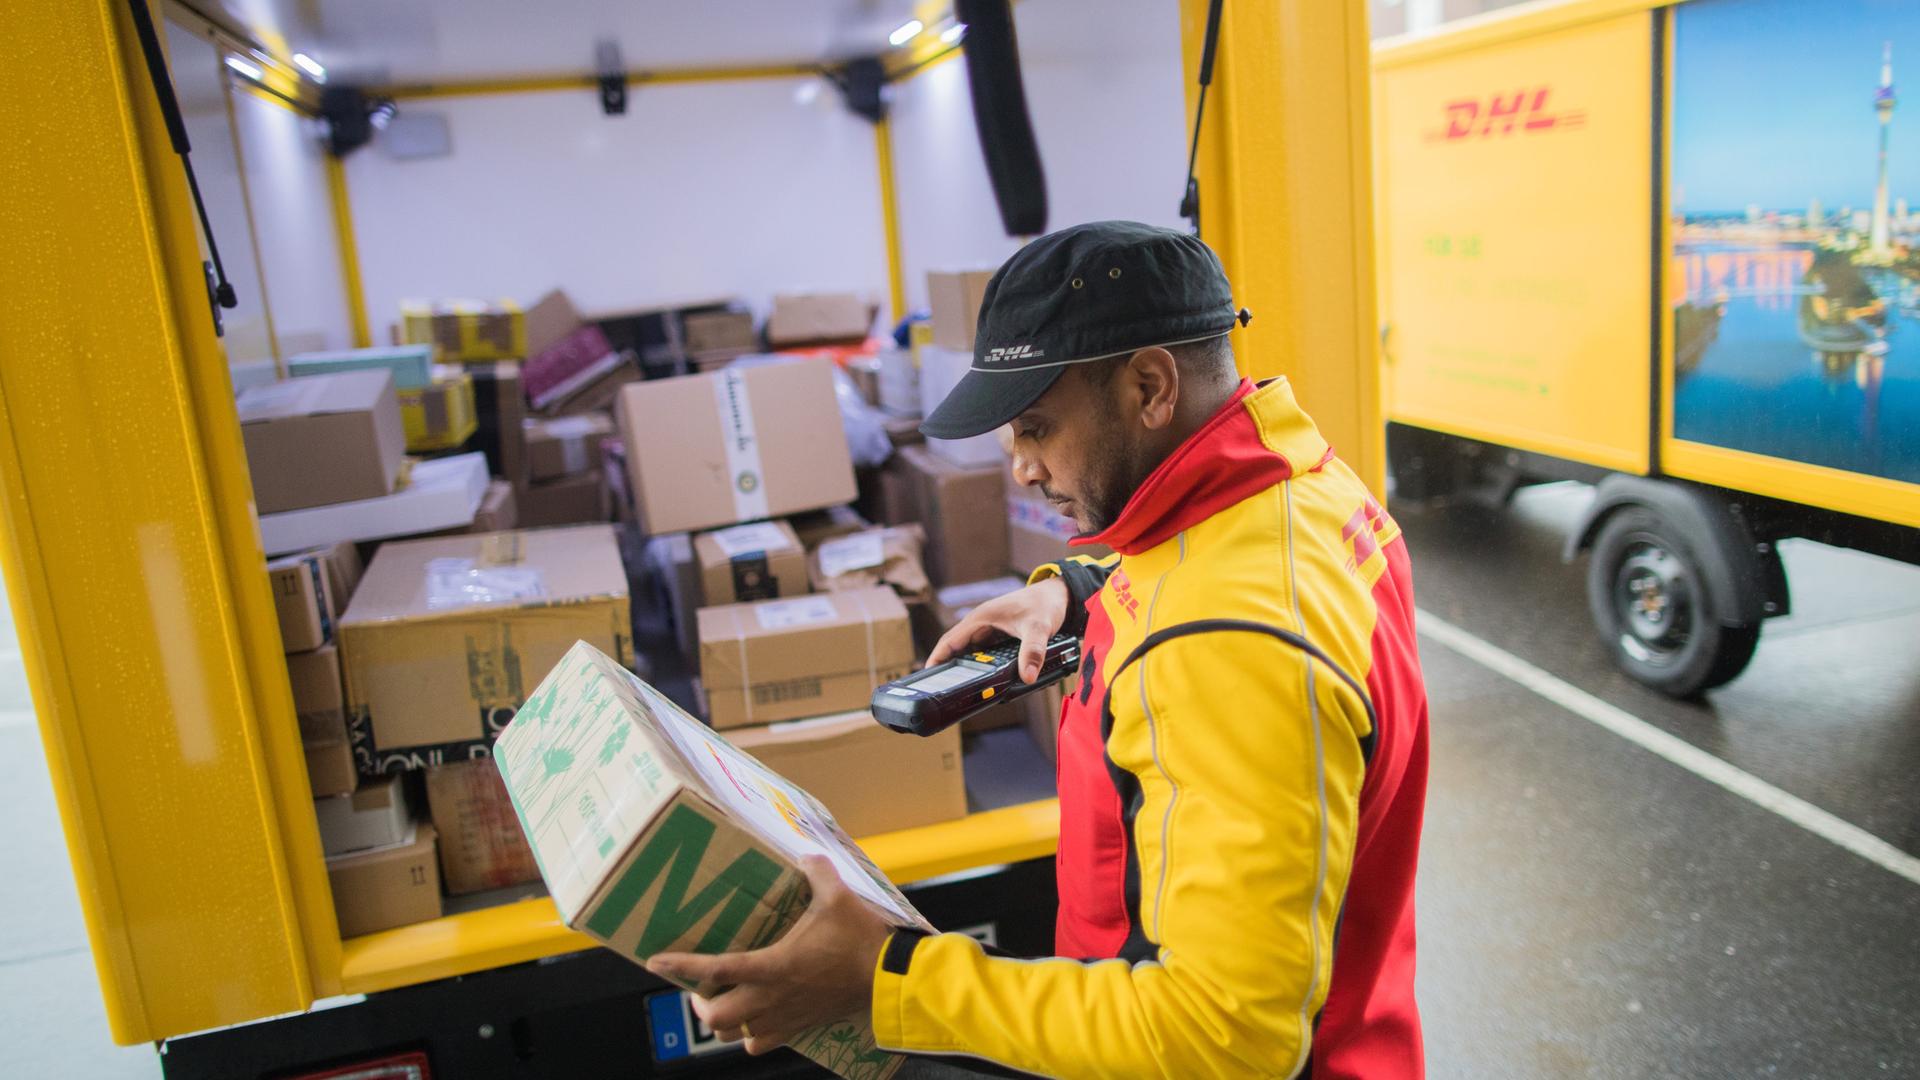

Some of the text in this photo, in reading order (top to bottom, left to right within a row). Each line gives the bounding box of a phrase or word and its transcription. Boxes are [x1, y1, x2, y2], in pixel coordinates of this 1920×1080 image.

[1446, 86, 1557, 140] DHL
[989, 344, 1034, 362] DHL
[1341, 492, 1390, 567] DH
[586, 803, 785, 988] M
